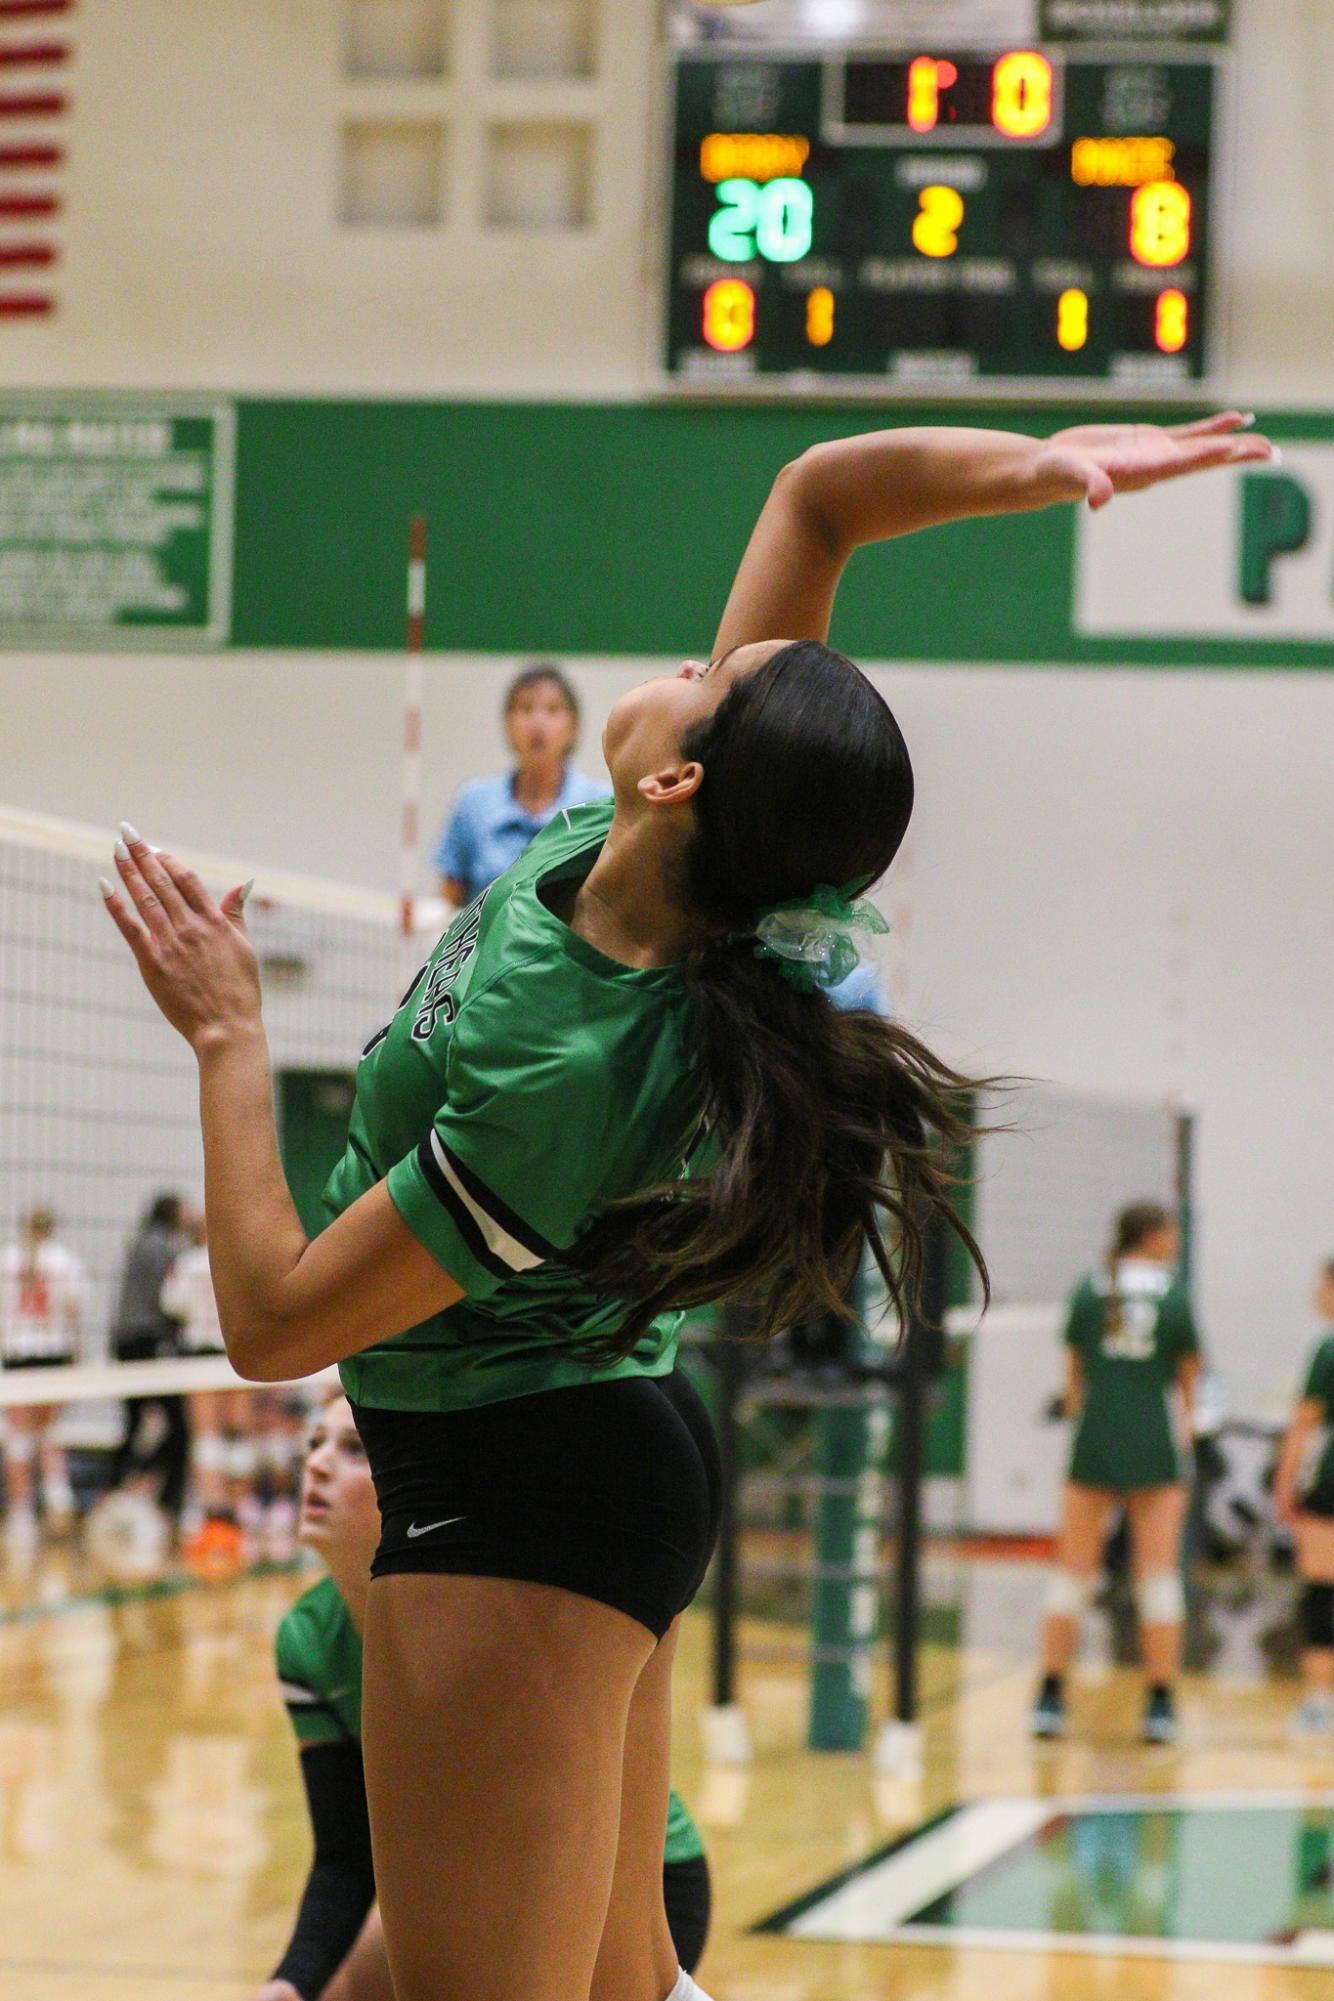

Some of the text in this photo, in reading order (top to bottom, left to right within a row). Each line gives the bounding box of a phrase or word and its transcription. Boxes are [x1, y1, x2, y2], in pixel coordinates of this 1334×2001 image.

[708, 177, 813, 262] 20
[912, 185, 964, 257] 2
[1130, 181, 1191, 267] 8
[1240, 470, 1334, 604] P
